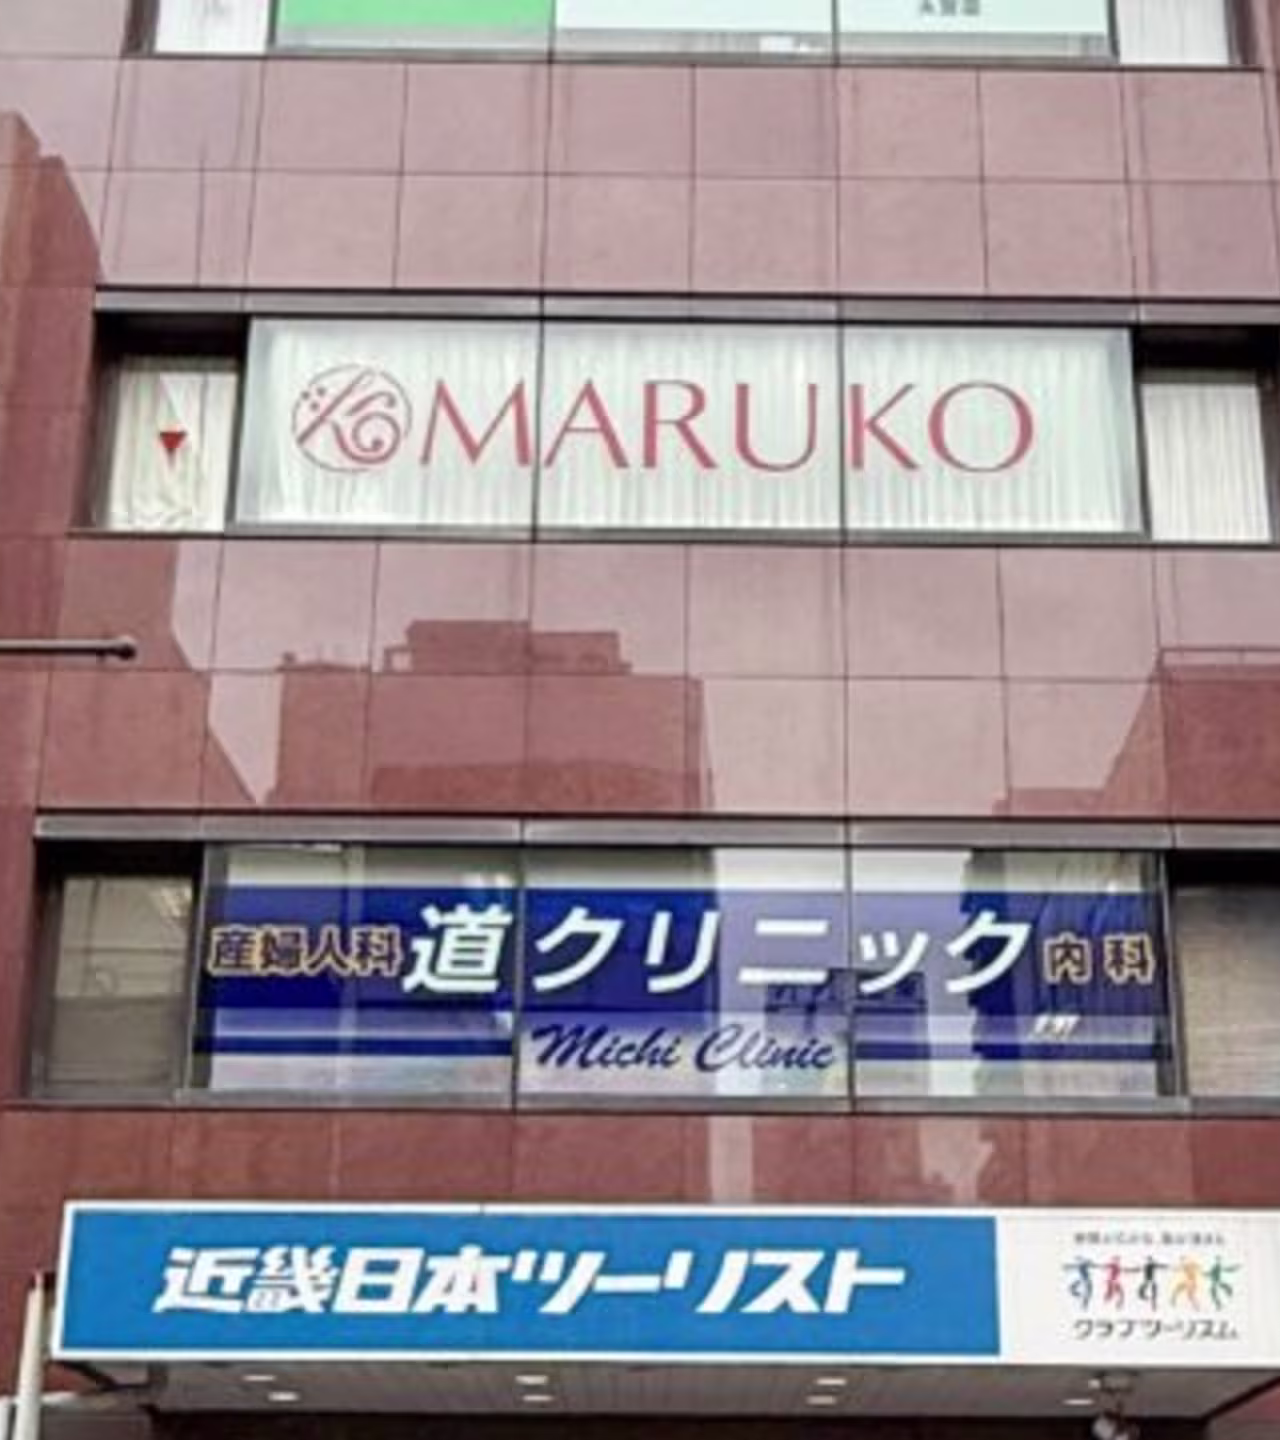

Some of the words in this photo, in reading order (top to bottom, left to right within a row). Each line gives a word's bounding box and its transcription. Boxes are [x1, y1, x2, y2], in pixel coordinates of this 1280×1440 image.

[419, 376, 1035, 474] MARUKO
[531, 1022, 682, 1070] Michi
[694, 1023, 837, 1073] Clinic
[151, 1245, 906, 1315] 近畿日本ツーリスト
